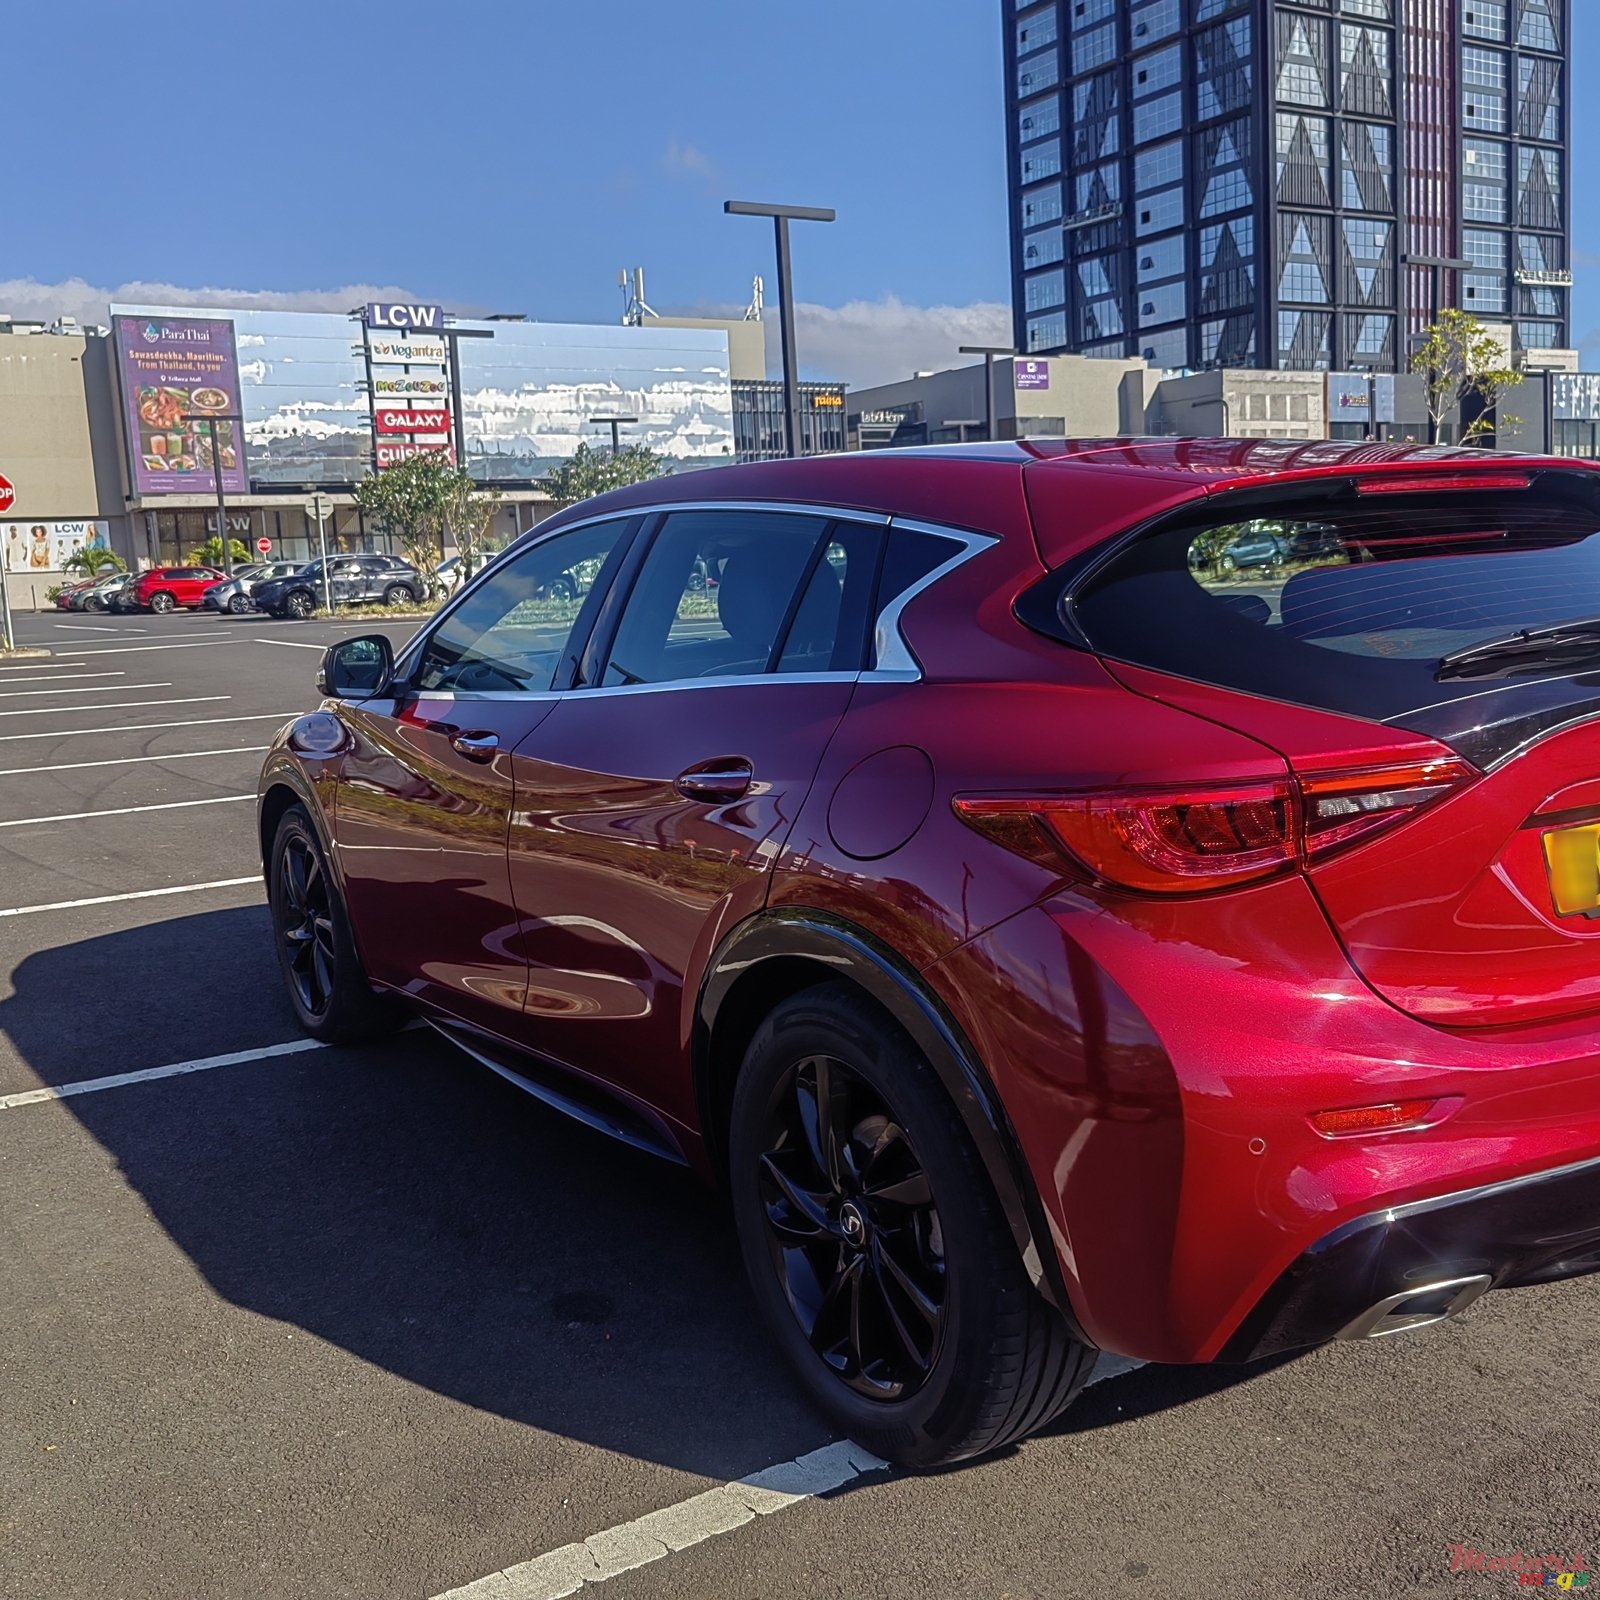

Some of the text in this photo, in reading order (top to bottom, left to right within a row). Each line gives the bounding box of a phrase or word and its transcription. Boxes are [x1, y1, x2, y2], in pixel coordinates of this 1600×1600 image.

[373, 305, 435, 327] LCW
[391, 344, 443, 359] Vegantra
[384, 412, 444, 427] GALAXY
[54, 523, 84, 534] LCW
